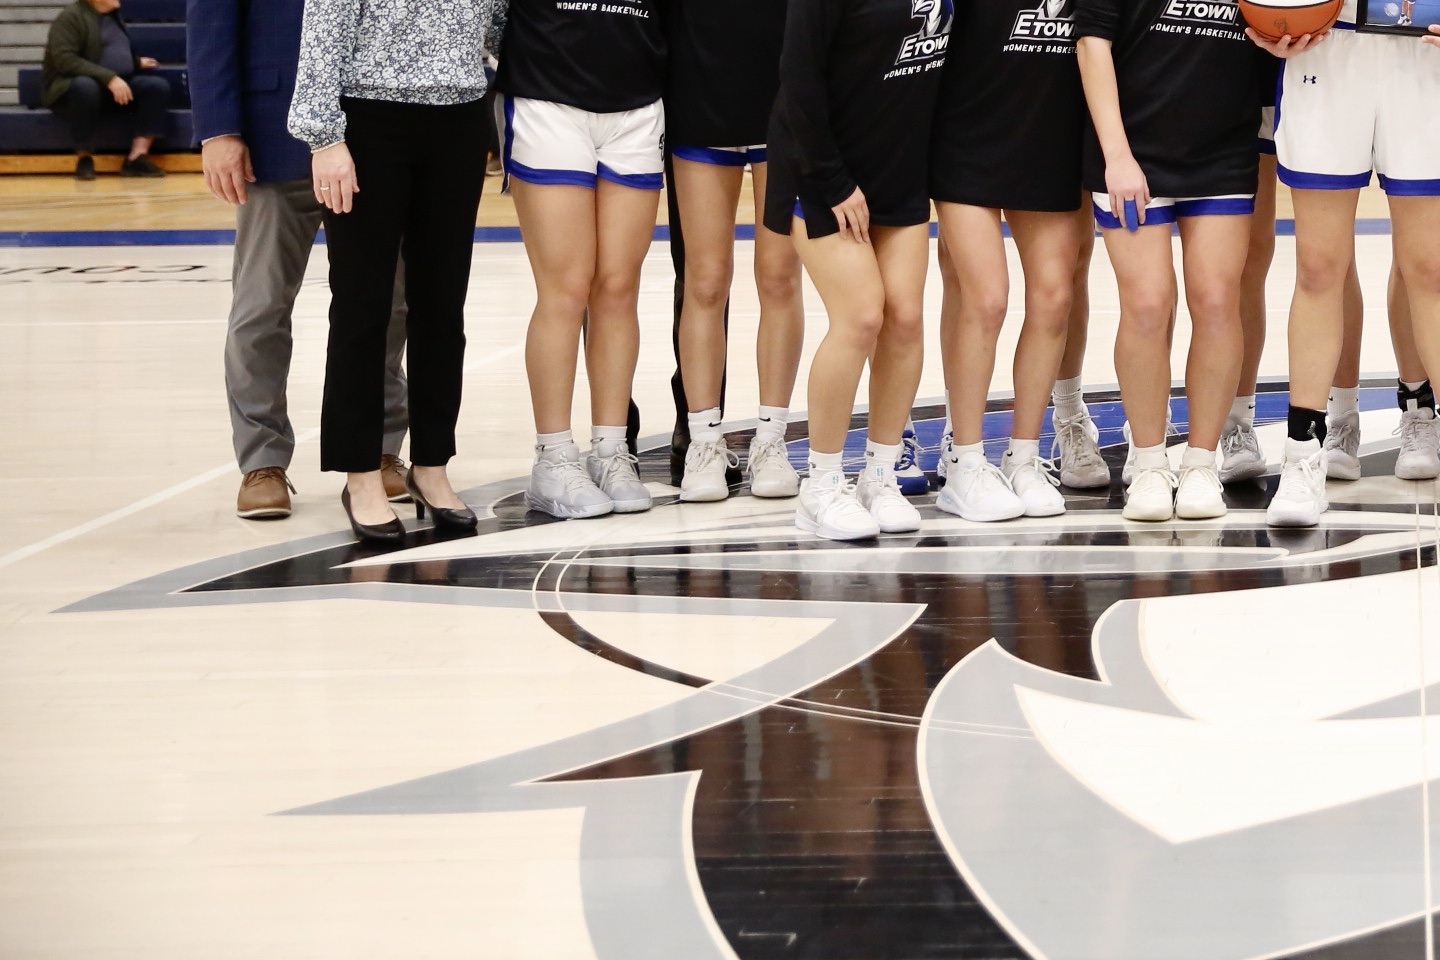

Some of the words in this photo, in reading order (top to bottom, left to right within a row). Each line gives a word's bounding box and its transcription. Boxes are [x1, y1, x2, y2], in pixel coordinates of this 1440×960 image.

[556, 2, 598, 11] WOMEN'S
[1014, 13, 1076, 37] ETOW
[1194, 27, 1247, 41] BASKETBALL
[1003, 43, 1043, 53] WOMEN'S
[1045, 45, 1078, 54] BASKET
